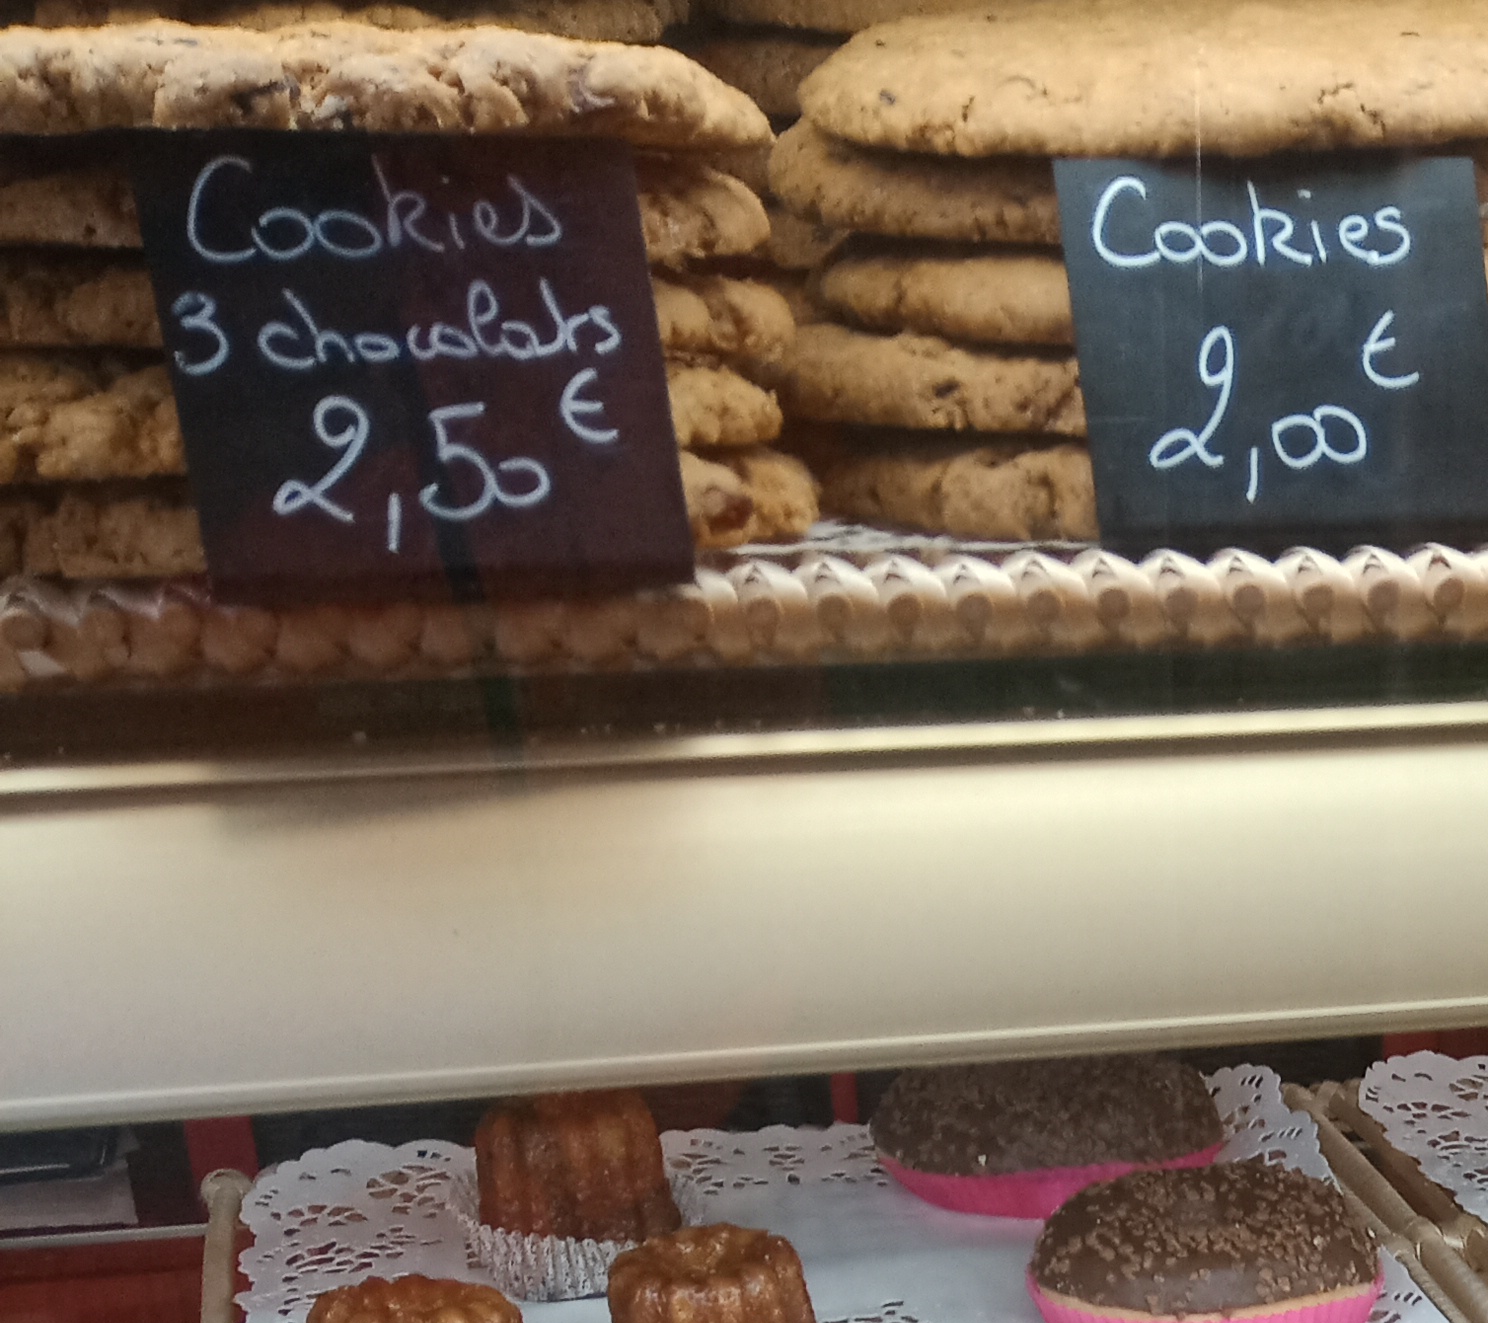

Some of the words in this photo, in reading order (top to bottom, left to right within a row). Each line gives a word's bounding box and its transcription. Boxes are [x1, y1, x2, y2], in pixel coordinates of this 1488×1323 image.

[188, 154, 563, 262] Cookies
[1092, 176, 1412, 267] Cookies
[170, 290, 230, 376] 3
[258, 277, 622, 369] chocolats
